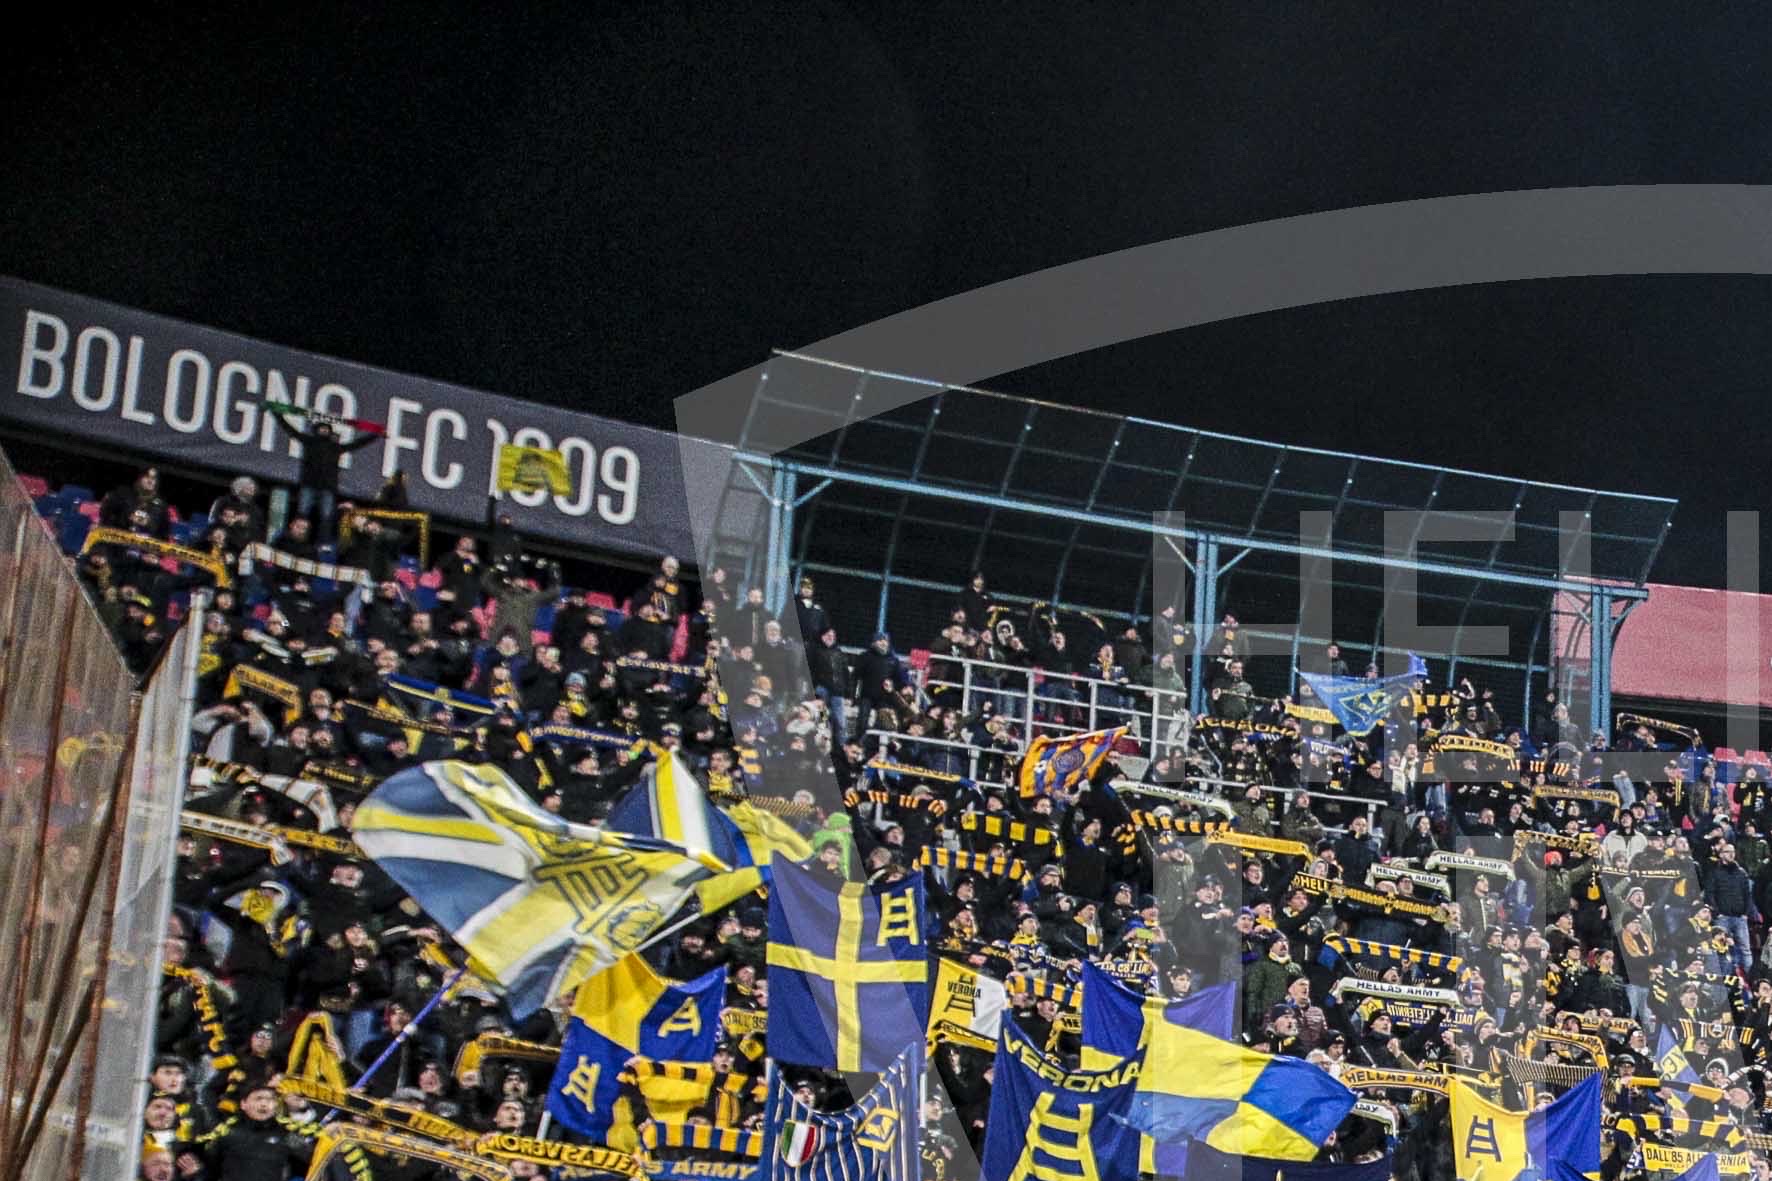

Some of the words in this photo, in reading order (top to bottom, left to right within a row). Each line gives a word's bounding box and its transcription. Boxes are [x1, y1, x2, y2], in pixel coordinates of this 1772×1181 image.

[381, 397, 467, 489] FC
[1356, 980, 1402, 994] HELLAS
[1406, 986, 1441, 998] ARMY
[1003, 1028, 1141, 1093] VERONA
[1346, 1069, 1406, 1083] HELLAS
[1413, 1075, 1449, 1089] ARM
[672, 1162, 758, 1180] ARMY
